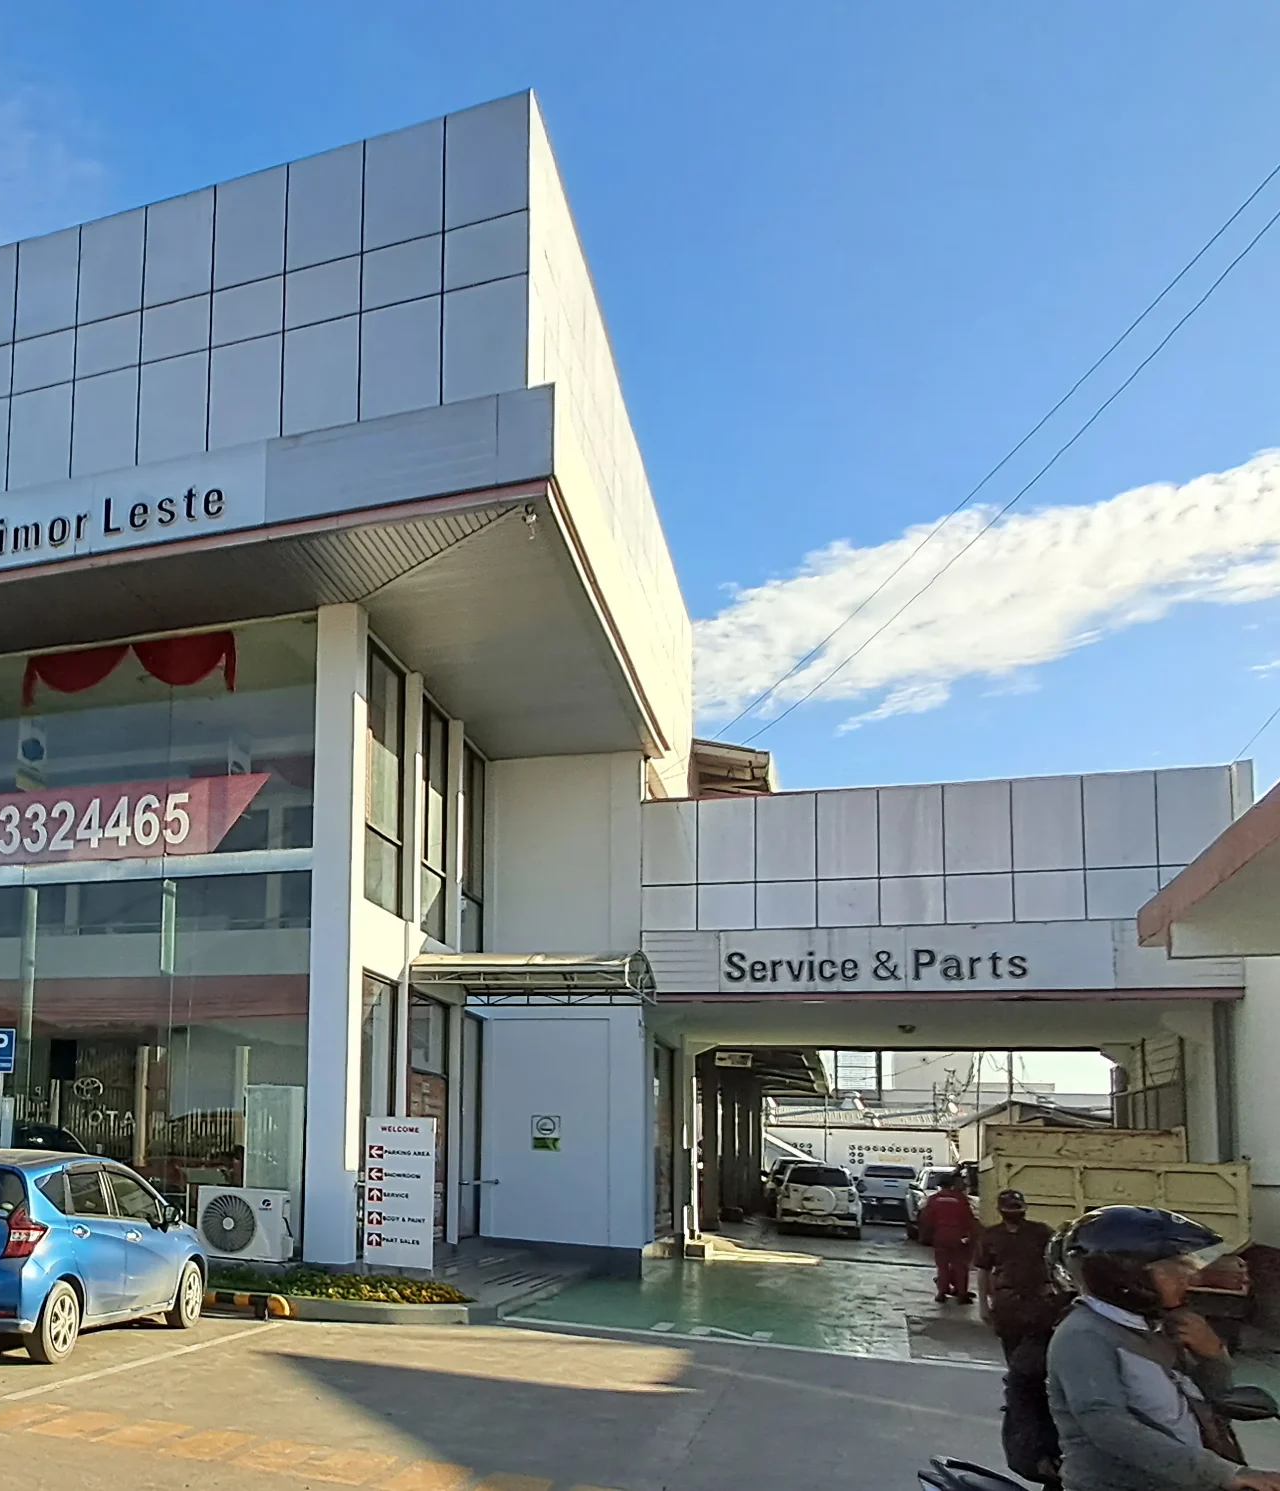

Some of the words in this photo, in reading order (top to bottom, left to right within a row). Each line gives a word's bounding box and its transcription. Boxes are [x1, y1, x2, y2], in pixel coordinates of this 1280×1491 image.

[103, 484, 226, 537] Leste
[723, 951, 860, 982] Service
[872, 949, 902, 981] &
[911, 948, 1029, 982] Parts
[380, 1125, 420, 1134] WELCOME
